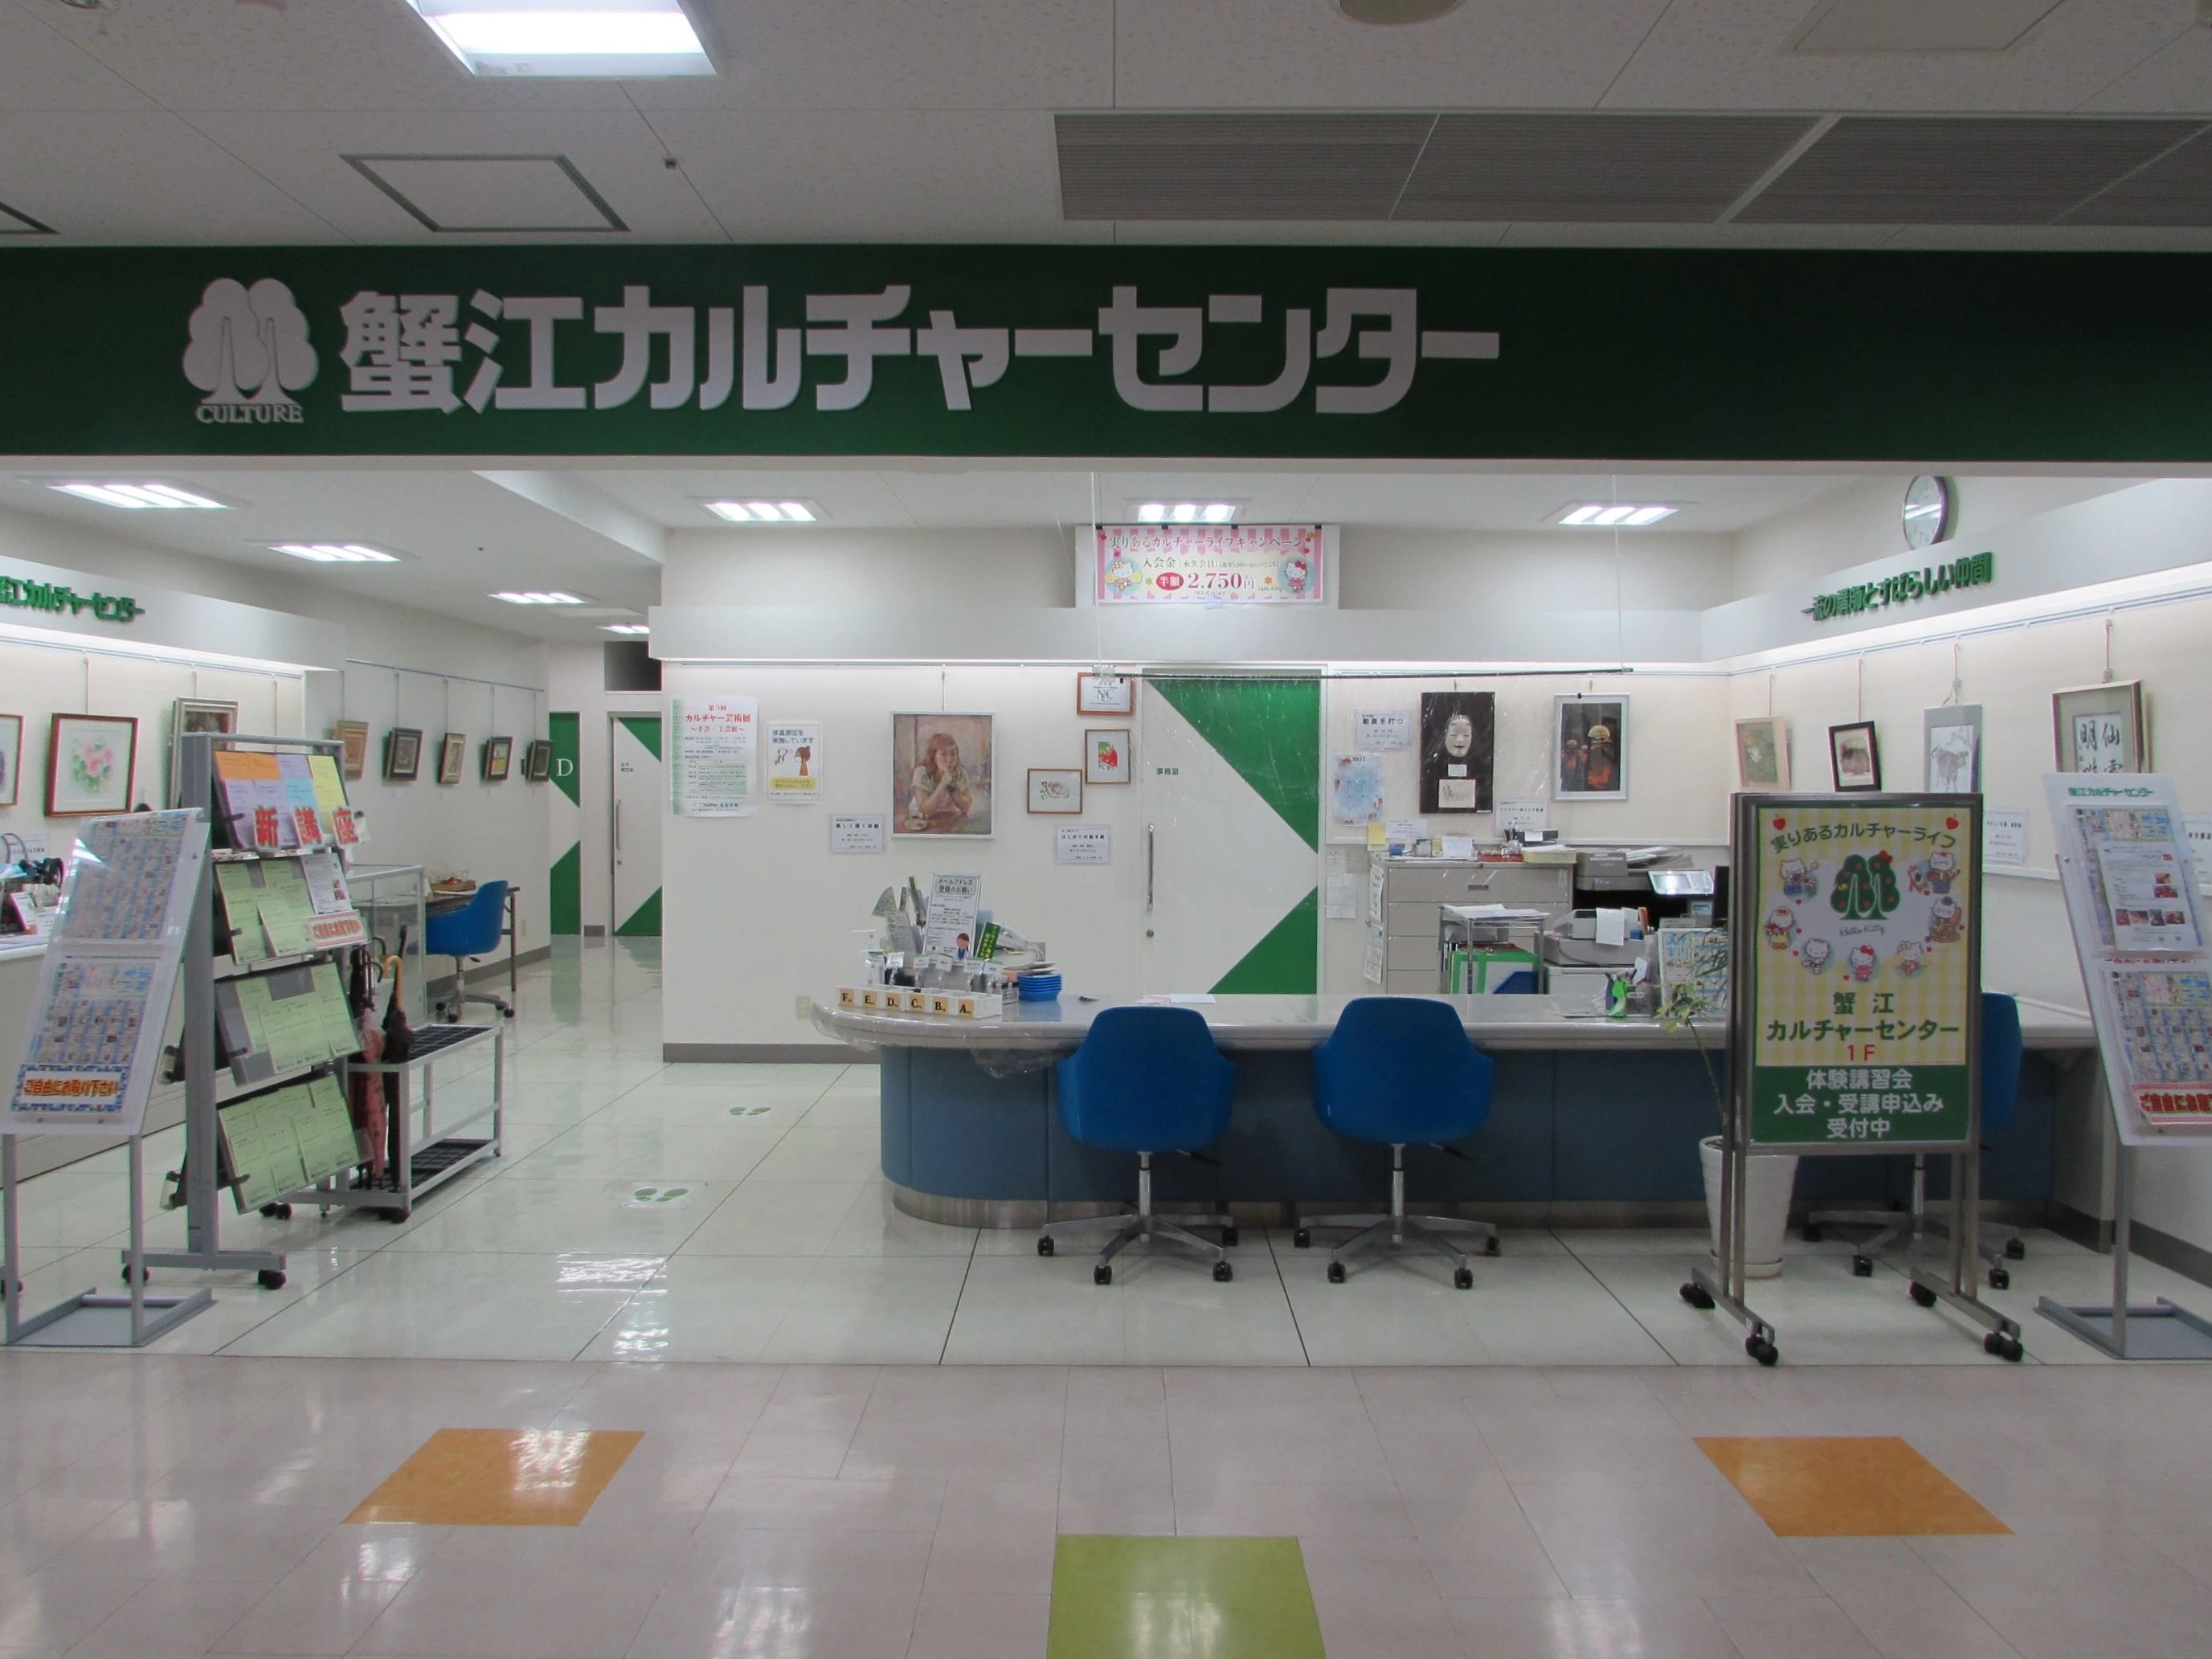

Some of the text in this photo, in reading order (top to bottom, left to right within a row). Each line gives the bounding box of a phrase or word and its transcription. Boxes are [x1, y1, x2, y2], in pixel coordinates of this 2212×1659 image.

[340, 284, 1500, 415] 蟹江カルチャーセンター
[195, 402, 305, 423] CULTURE
[1143, 557, 1176, 568] 入会金
[556, 758, 574, 777] D
[1770, 823, 1956, 854] 実りあるカルチャーライフ
[1833, 991, 1895, 1015] 蟹江
[1766, 1019, 1960, 1042] カルチャーセンター
[1847, 1044, 1875, 1061] 1F
[1805, 1068, 1914, 1090] 体験講習会
[1773, 1093, 1944, 1115] 入会・受講申込み
[1826, 1118, 1891, 1139] 受付中
